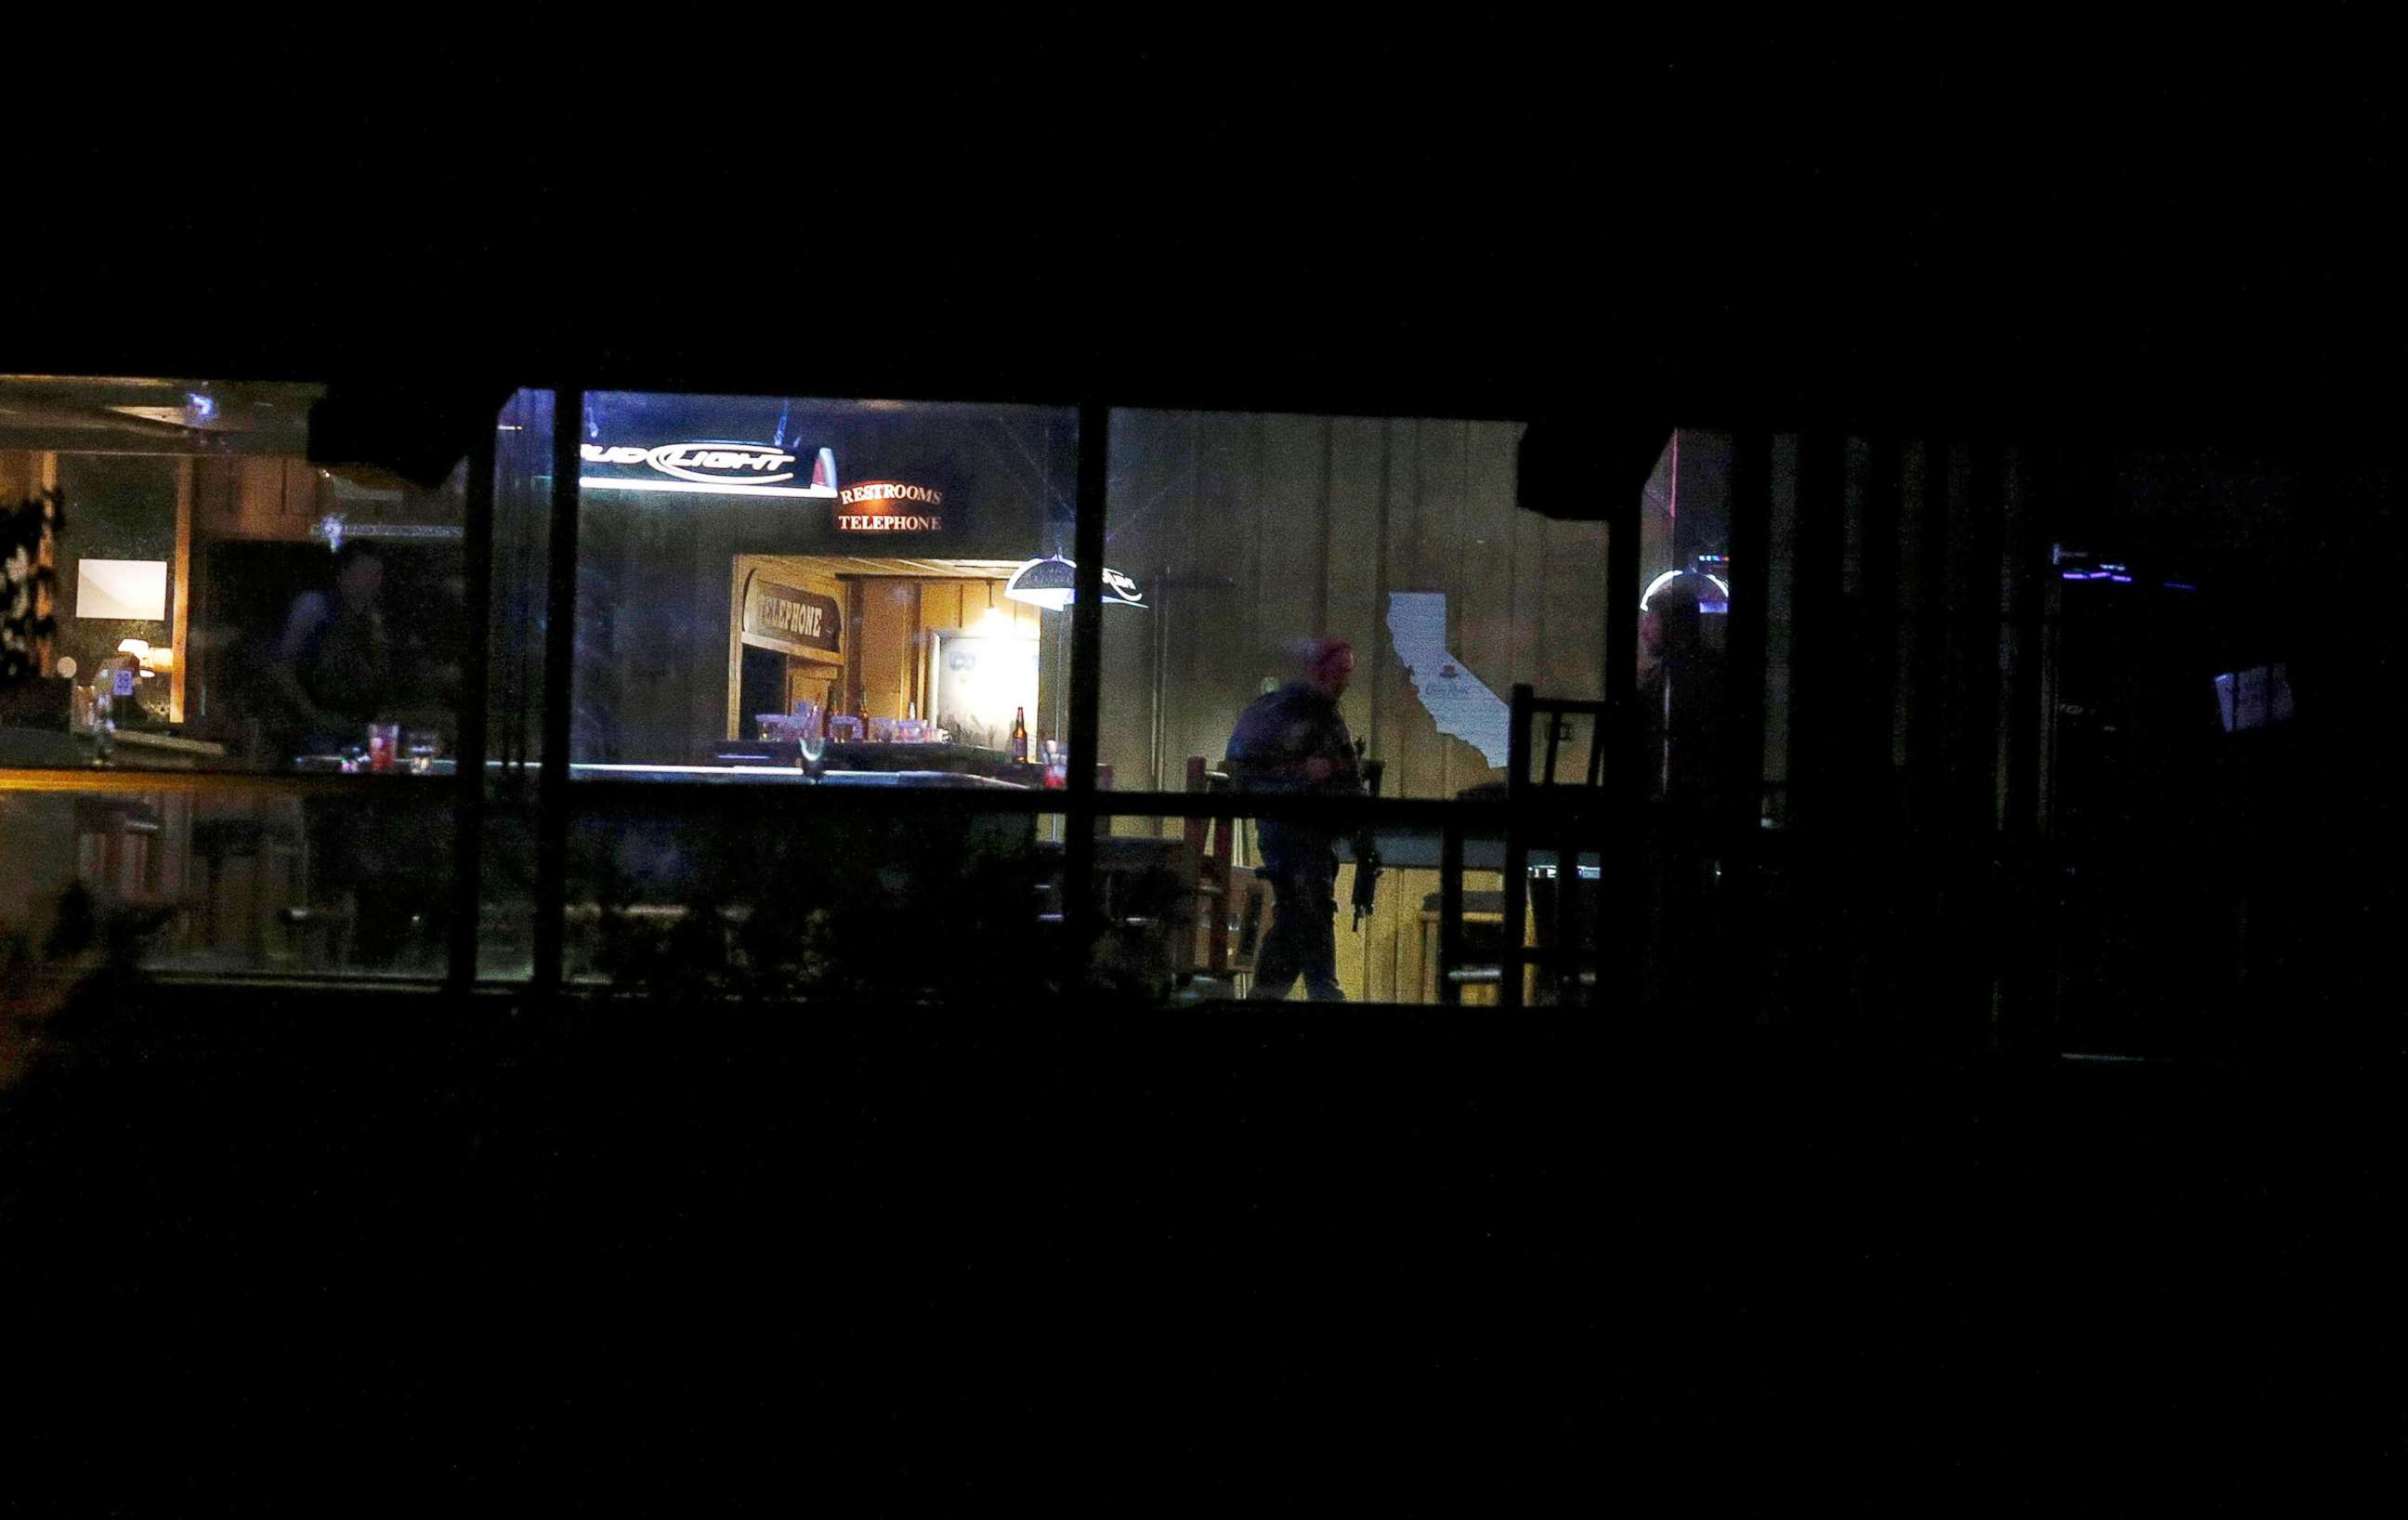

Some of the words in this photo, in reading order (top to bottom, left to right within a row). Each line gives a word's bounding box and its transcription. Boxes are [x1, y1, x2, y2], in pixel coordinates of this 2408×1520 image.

[670, 450, 795, 471] LIGHT
[840, 483, 943, 504] RESTROOMS
[838, 515, 942, 531] TELEPHONE
